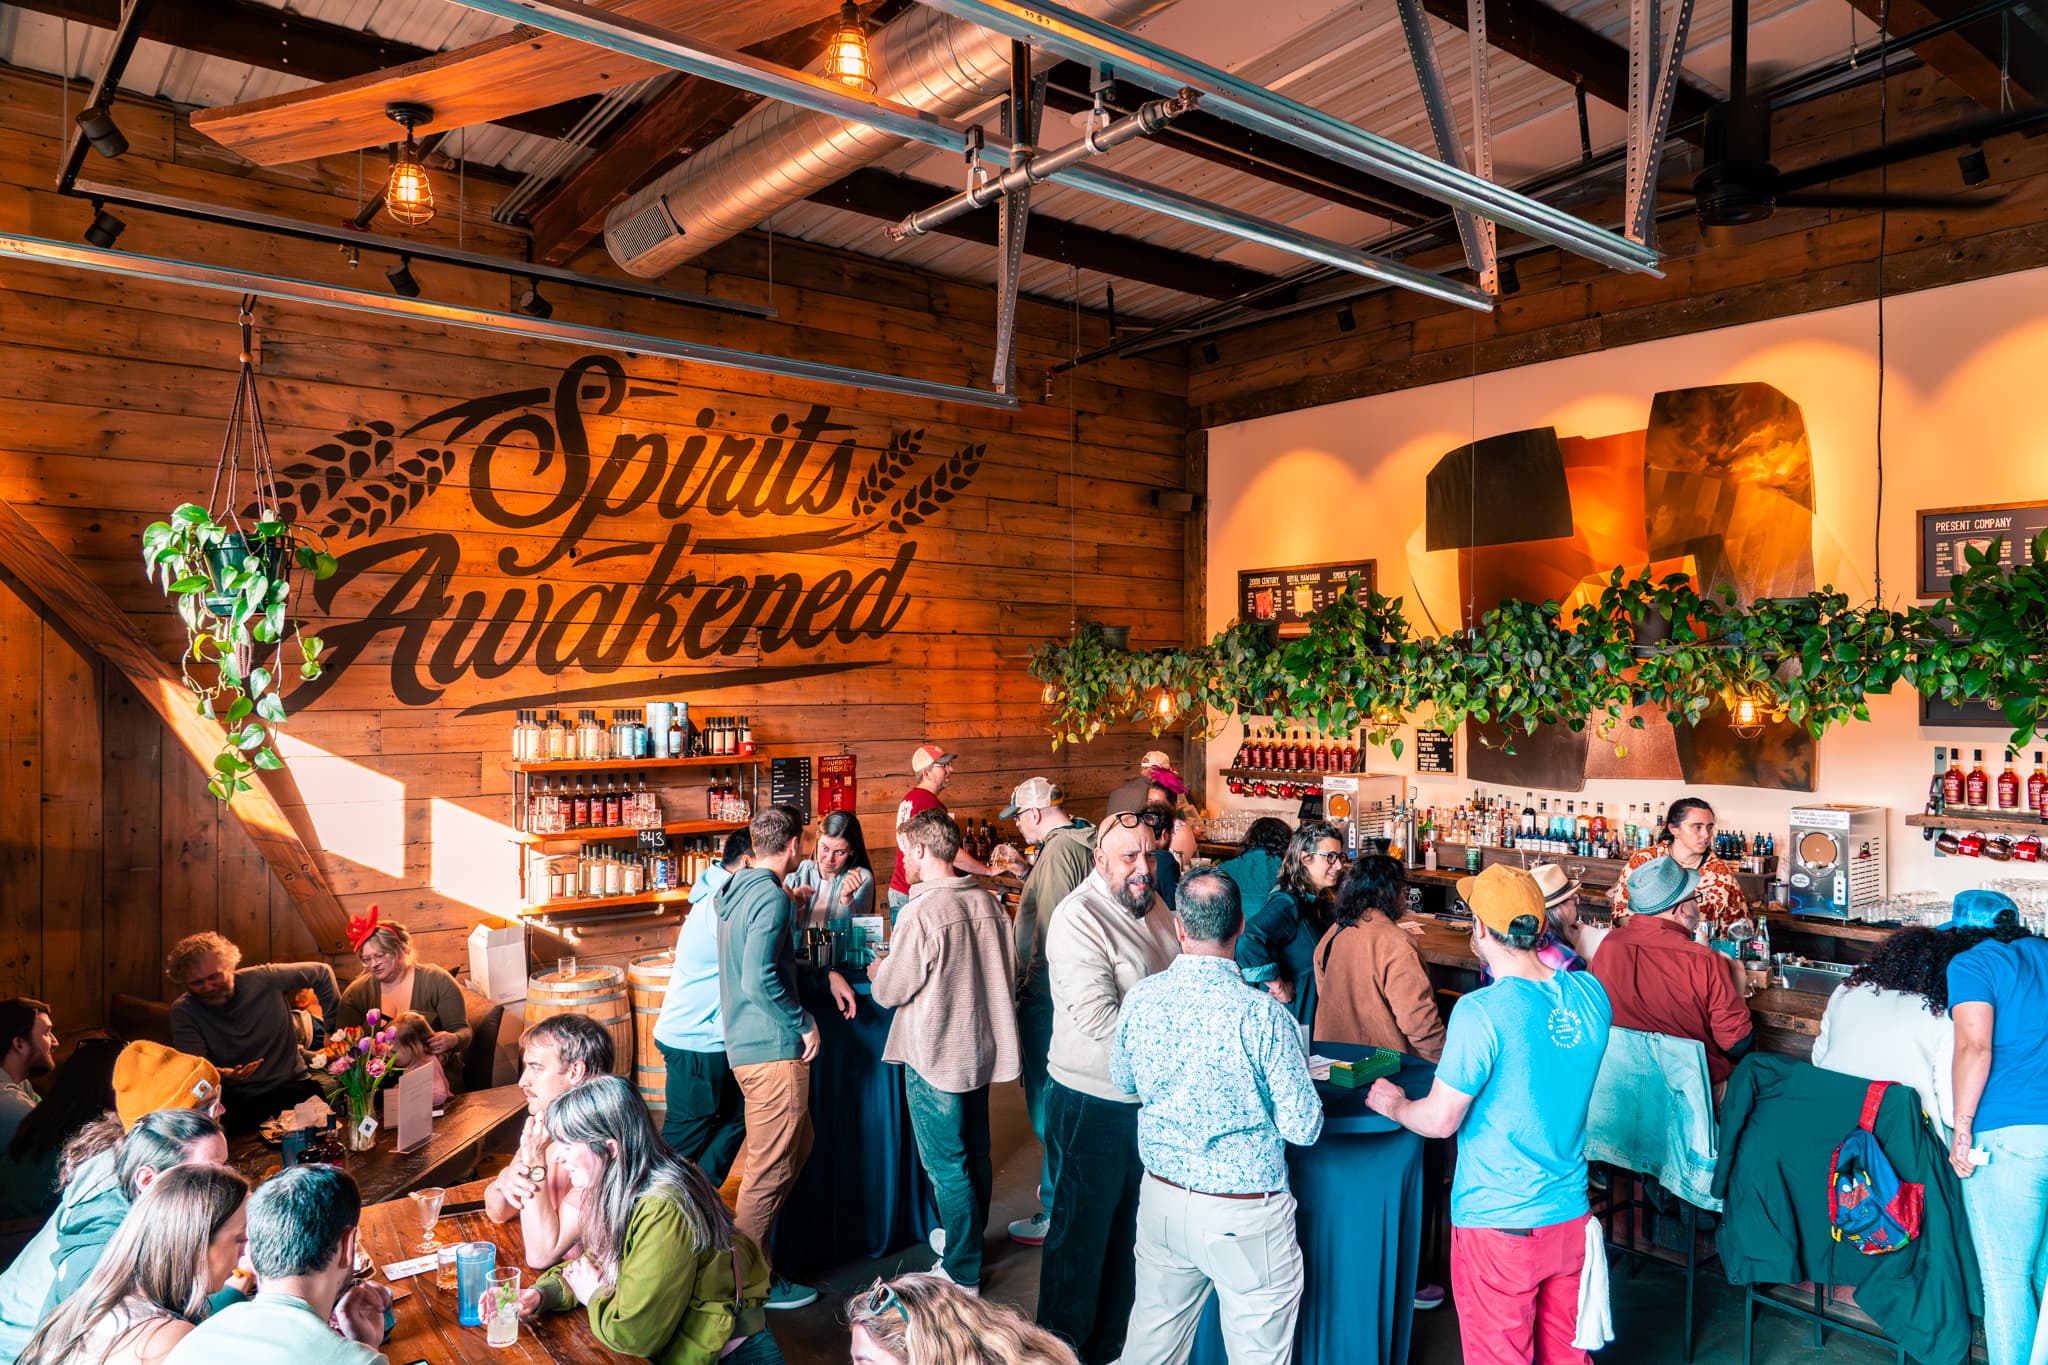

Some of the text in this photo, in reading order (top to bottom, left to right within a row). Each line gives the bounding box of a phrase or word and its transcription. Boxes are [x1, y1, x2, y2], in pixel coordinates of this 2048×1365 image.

[469, 354, 857, 577] Spirits
[1935, 517, 2012, 532] PRESENT COMPANY
[266, 524, 917, 718] Awakened
[821, 765, 853, 773] WHISKEY
[822, 759, 852, 767] BOURBON
[640, 831, 665, 848] $43
